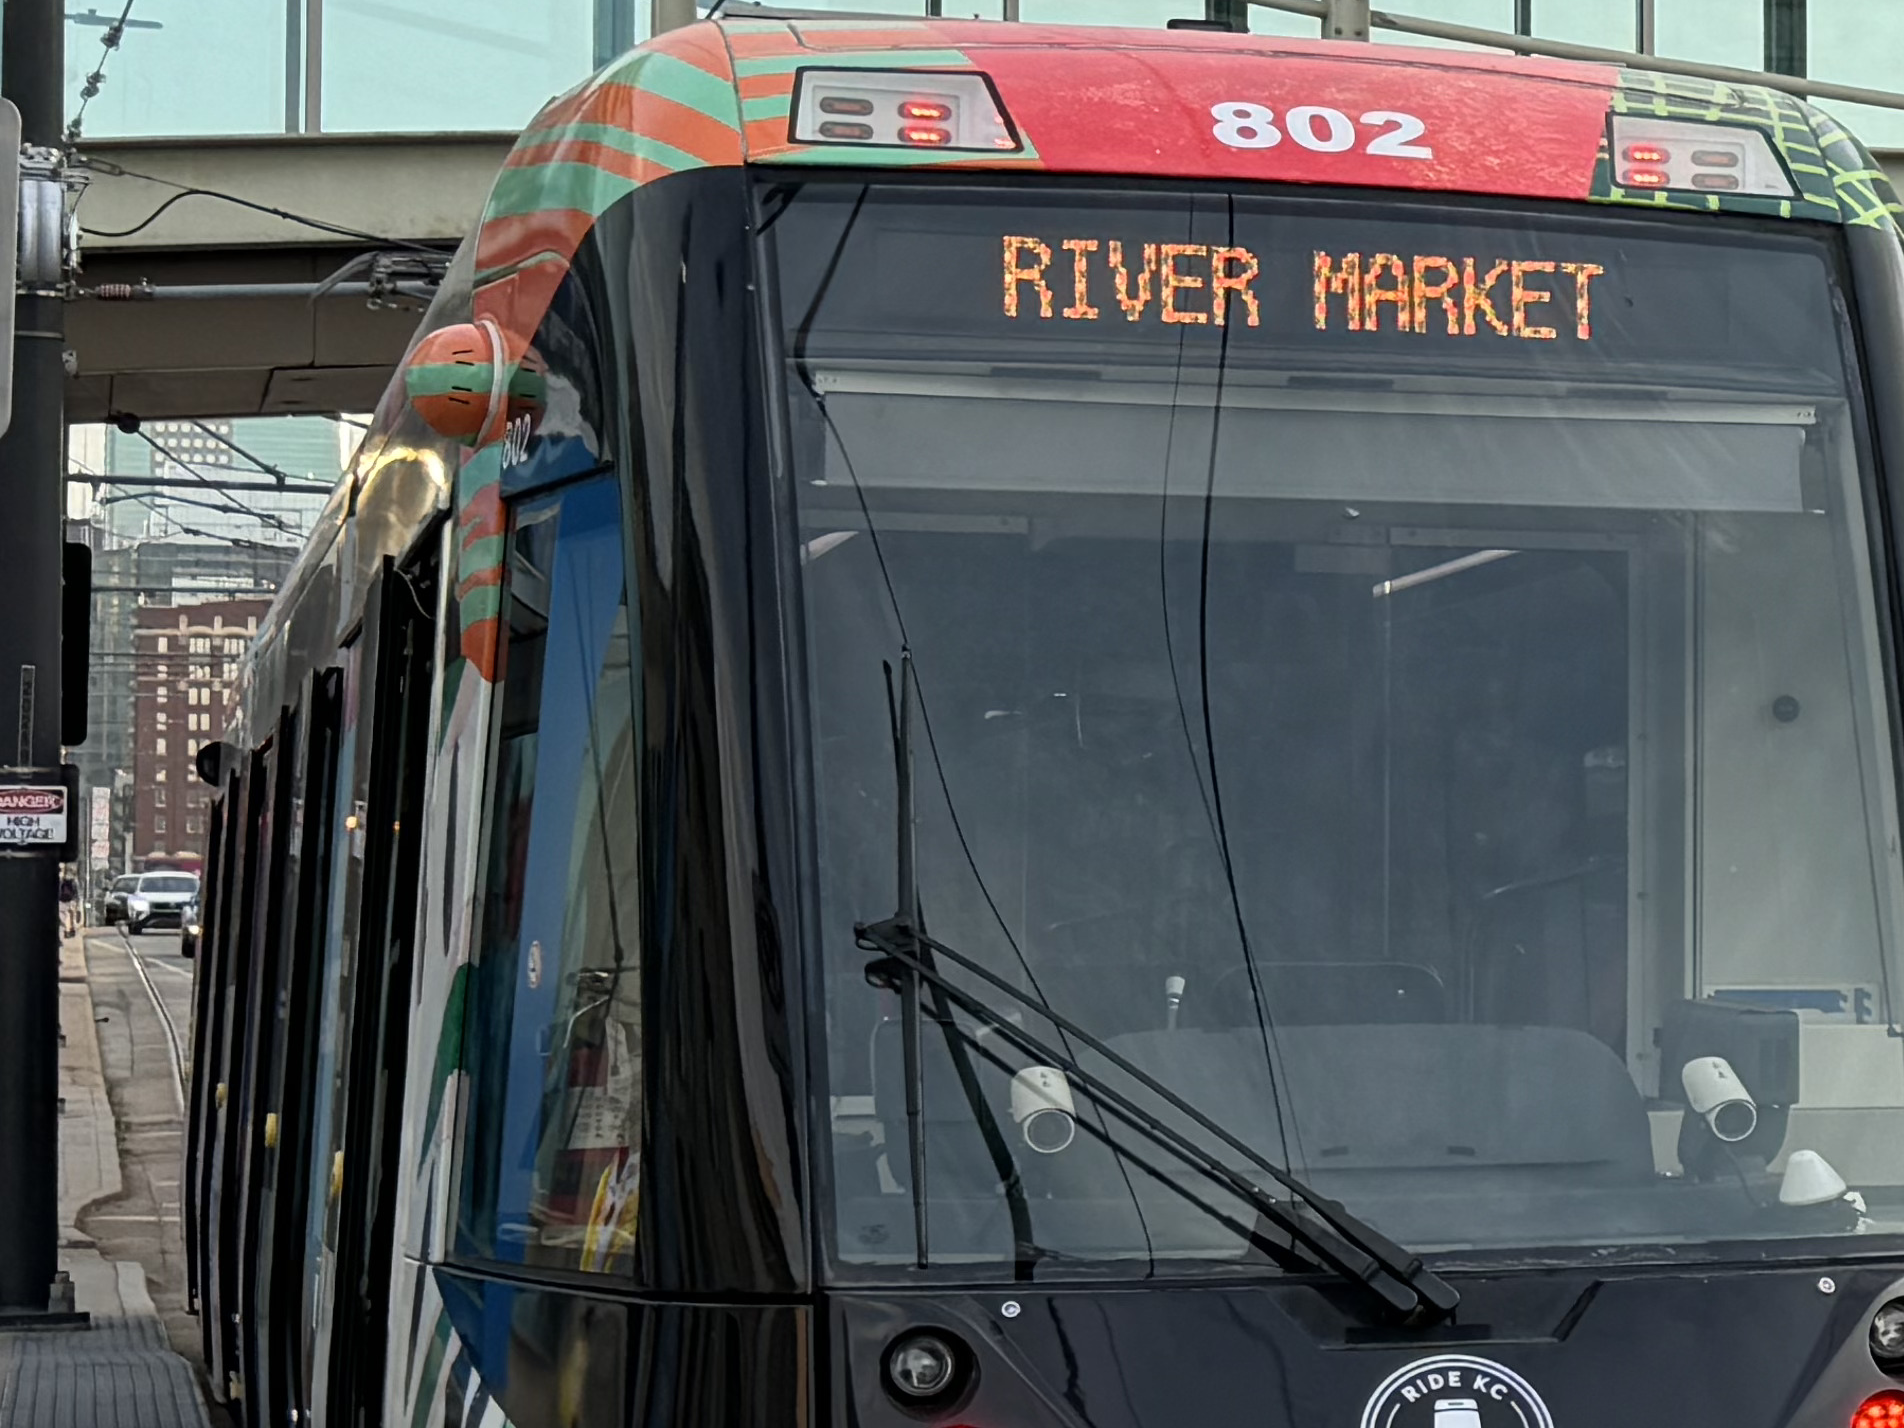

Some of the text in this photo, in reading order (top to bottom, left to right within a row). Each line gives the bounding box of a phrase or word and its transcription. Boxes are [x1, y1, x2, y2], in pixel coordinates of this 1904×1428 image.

[1210, 101, 1433, 160] 802
[1002, 235, 1604, 341] RIVER MARKET
[502, 413, 532, 470] 802
[0, 794, 57, 809] ANGER
[1400, 1370, 1509, 1403] RIDE KC
